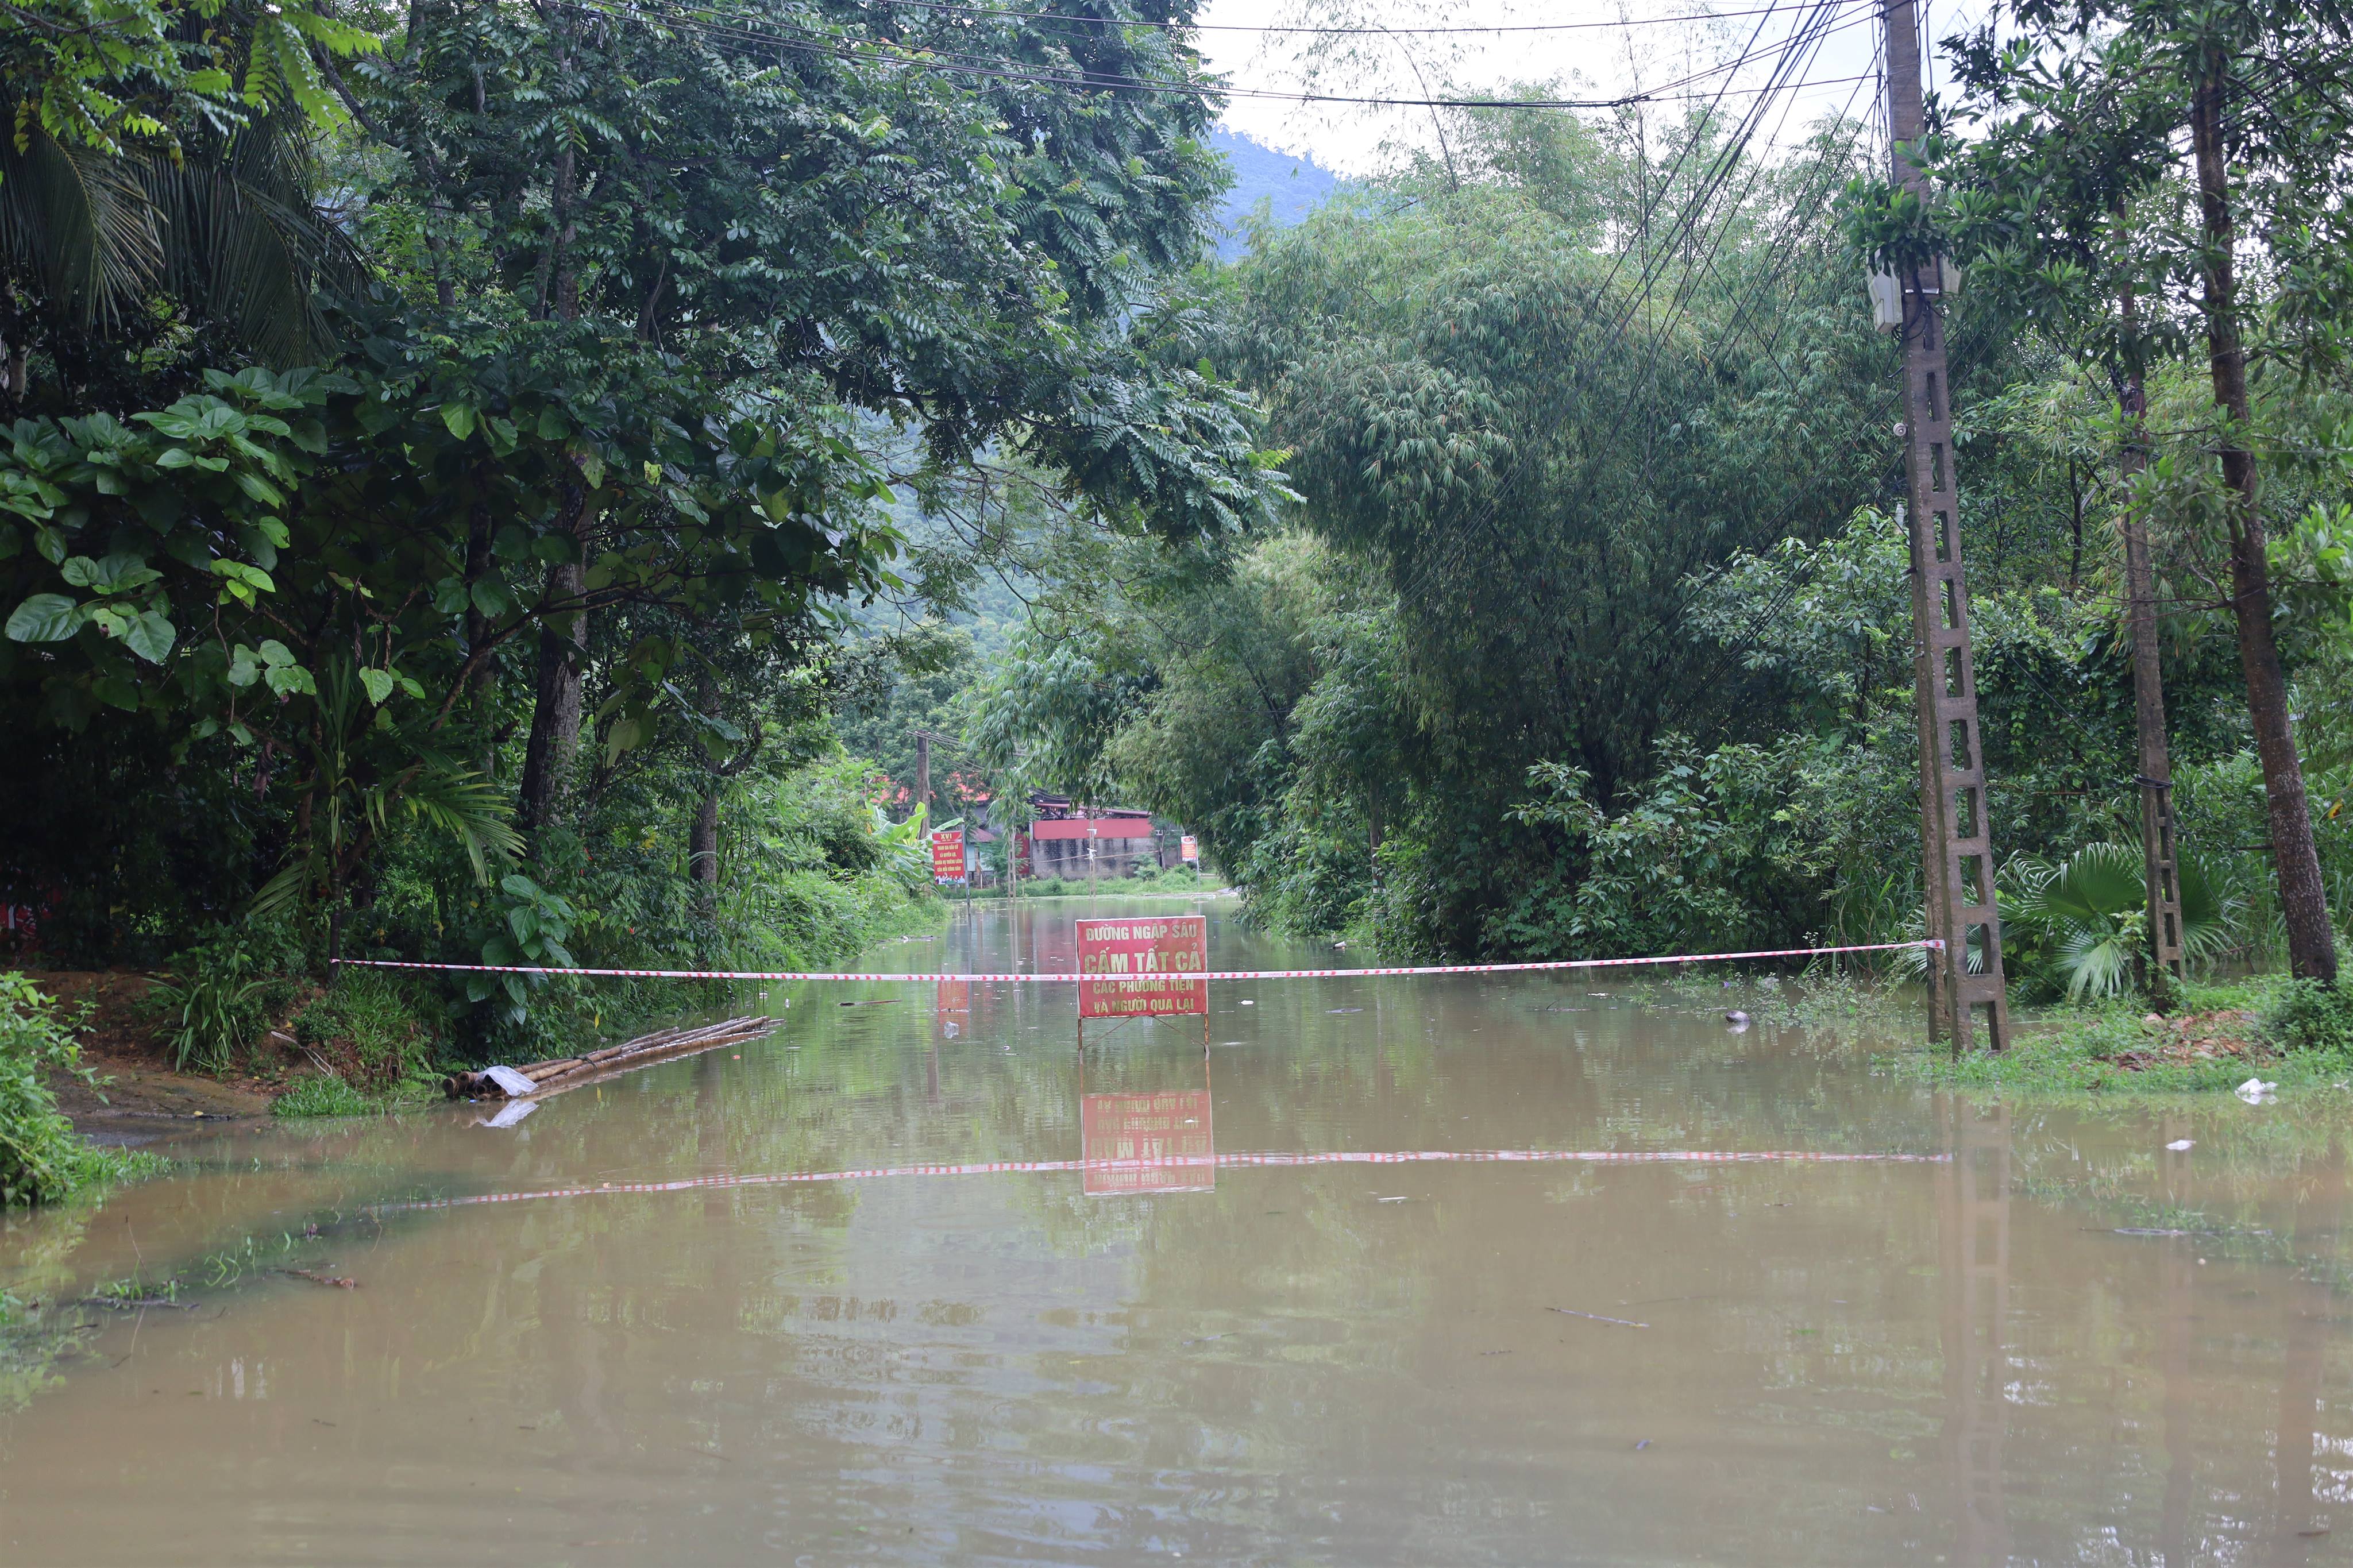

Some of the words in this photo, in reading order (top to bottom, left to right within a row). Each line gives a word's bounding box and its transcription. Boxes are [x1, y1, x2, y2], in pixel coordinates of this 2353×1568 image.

[1086, 924, 1129, 941] ĐƯỜNG
[1133, 922, 1168, 942] NGẬP
[1172, 921, 1197, 938] SÂU
[1084, 946, 1128, 974] CẤM
[1134, 945, 1169, 972] TẤT
[1175, 942, 1202, 971] CẢ
[1093, 980, 1116, 994] CÁC
[1118, 980, 1166, 993] PHƯƠNG
[1094, 999, 1109, 1013] VÀ
[1112, 996, 1147, 1012] NGƯỜI
[1150, 998, 1173, 1012] QUA
[1176, 998, 1194, 1013] LẠI
